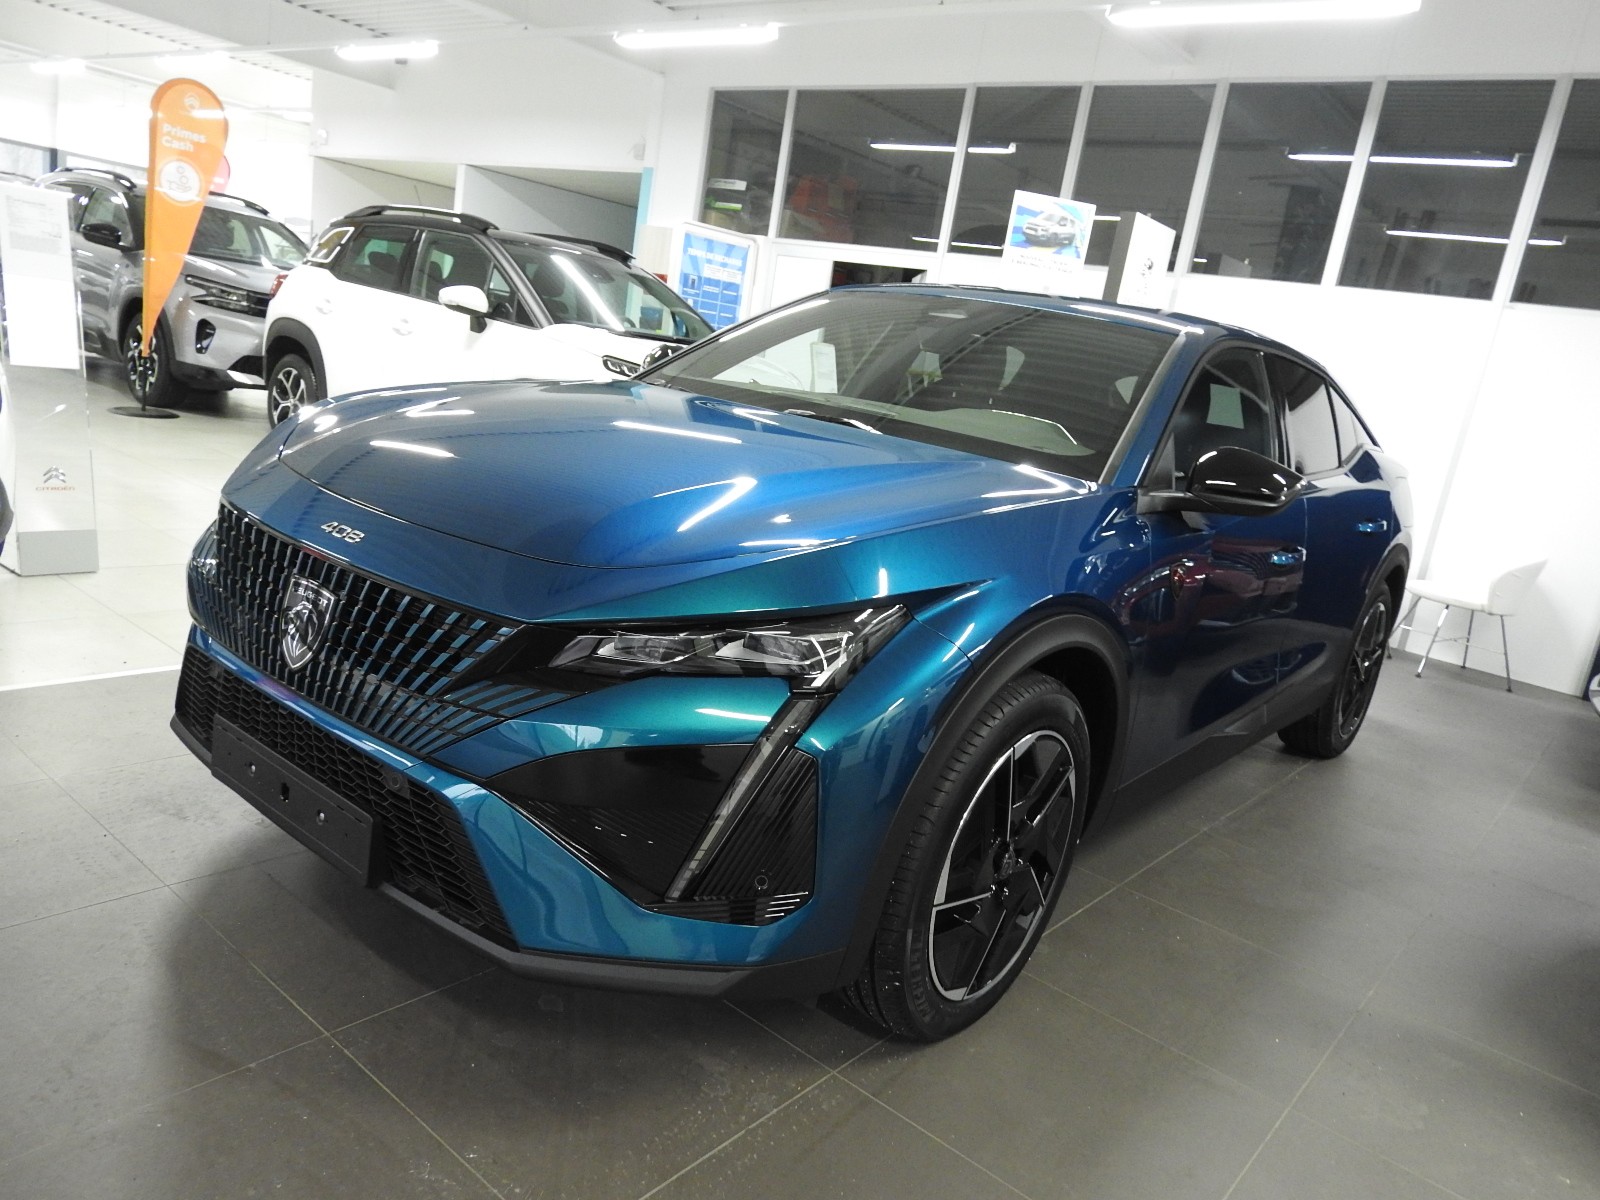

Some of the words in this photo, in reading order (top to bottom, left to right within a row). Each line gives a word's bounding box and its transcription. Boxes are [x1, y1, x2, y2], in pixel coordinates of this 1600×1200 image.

[161, 135, 195, 153] Cash
[162, 123, 207, 144] Primes
[320, 521, 366, 543] 408
